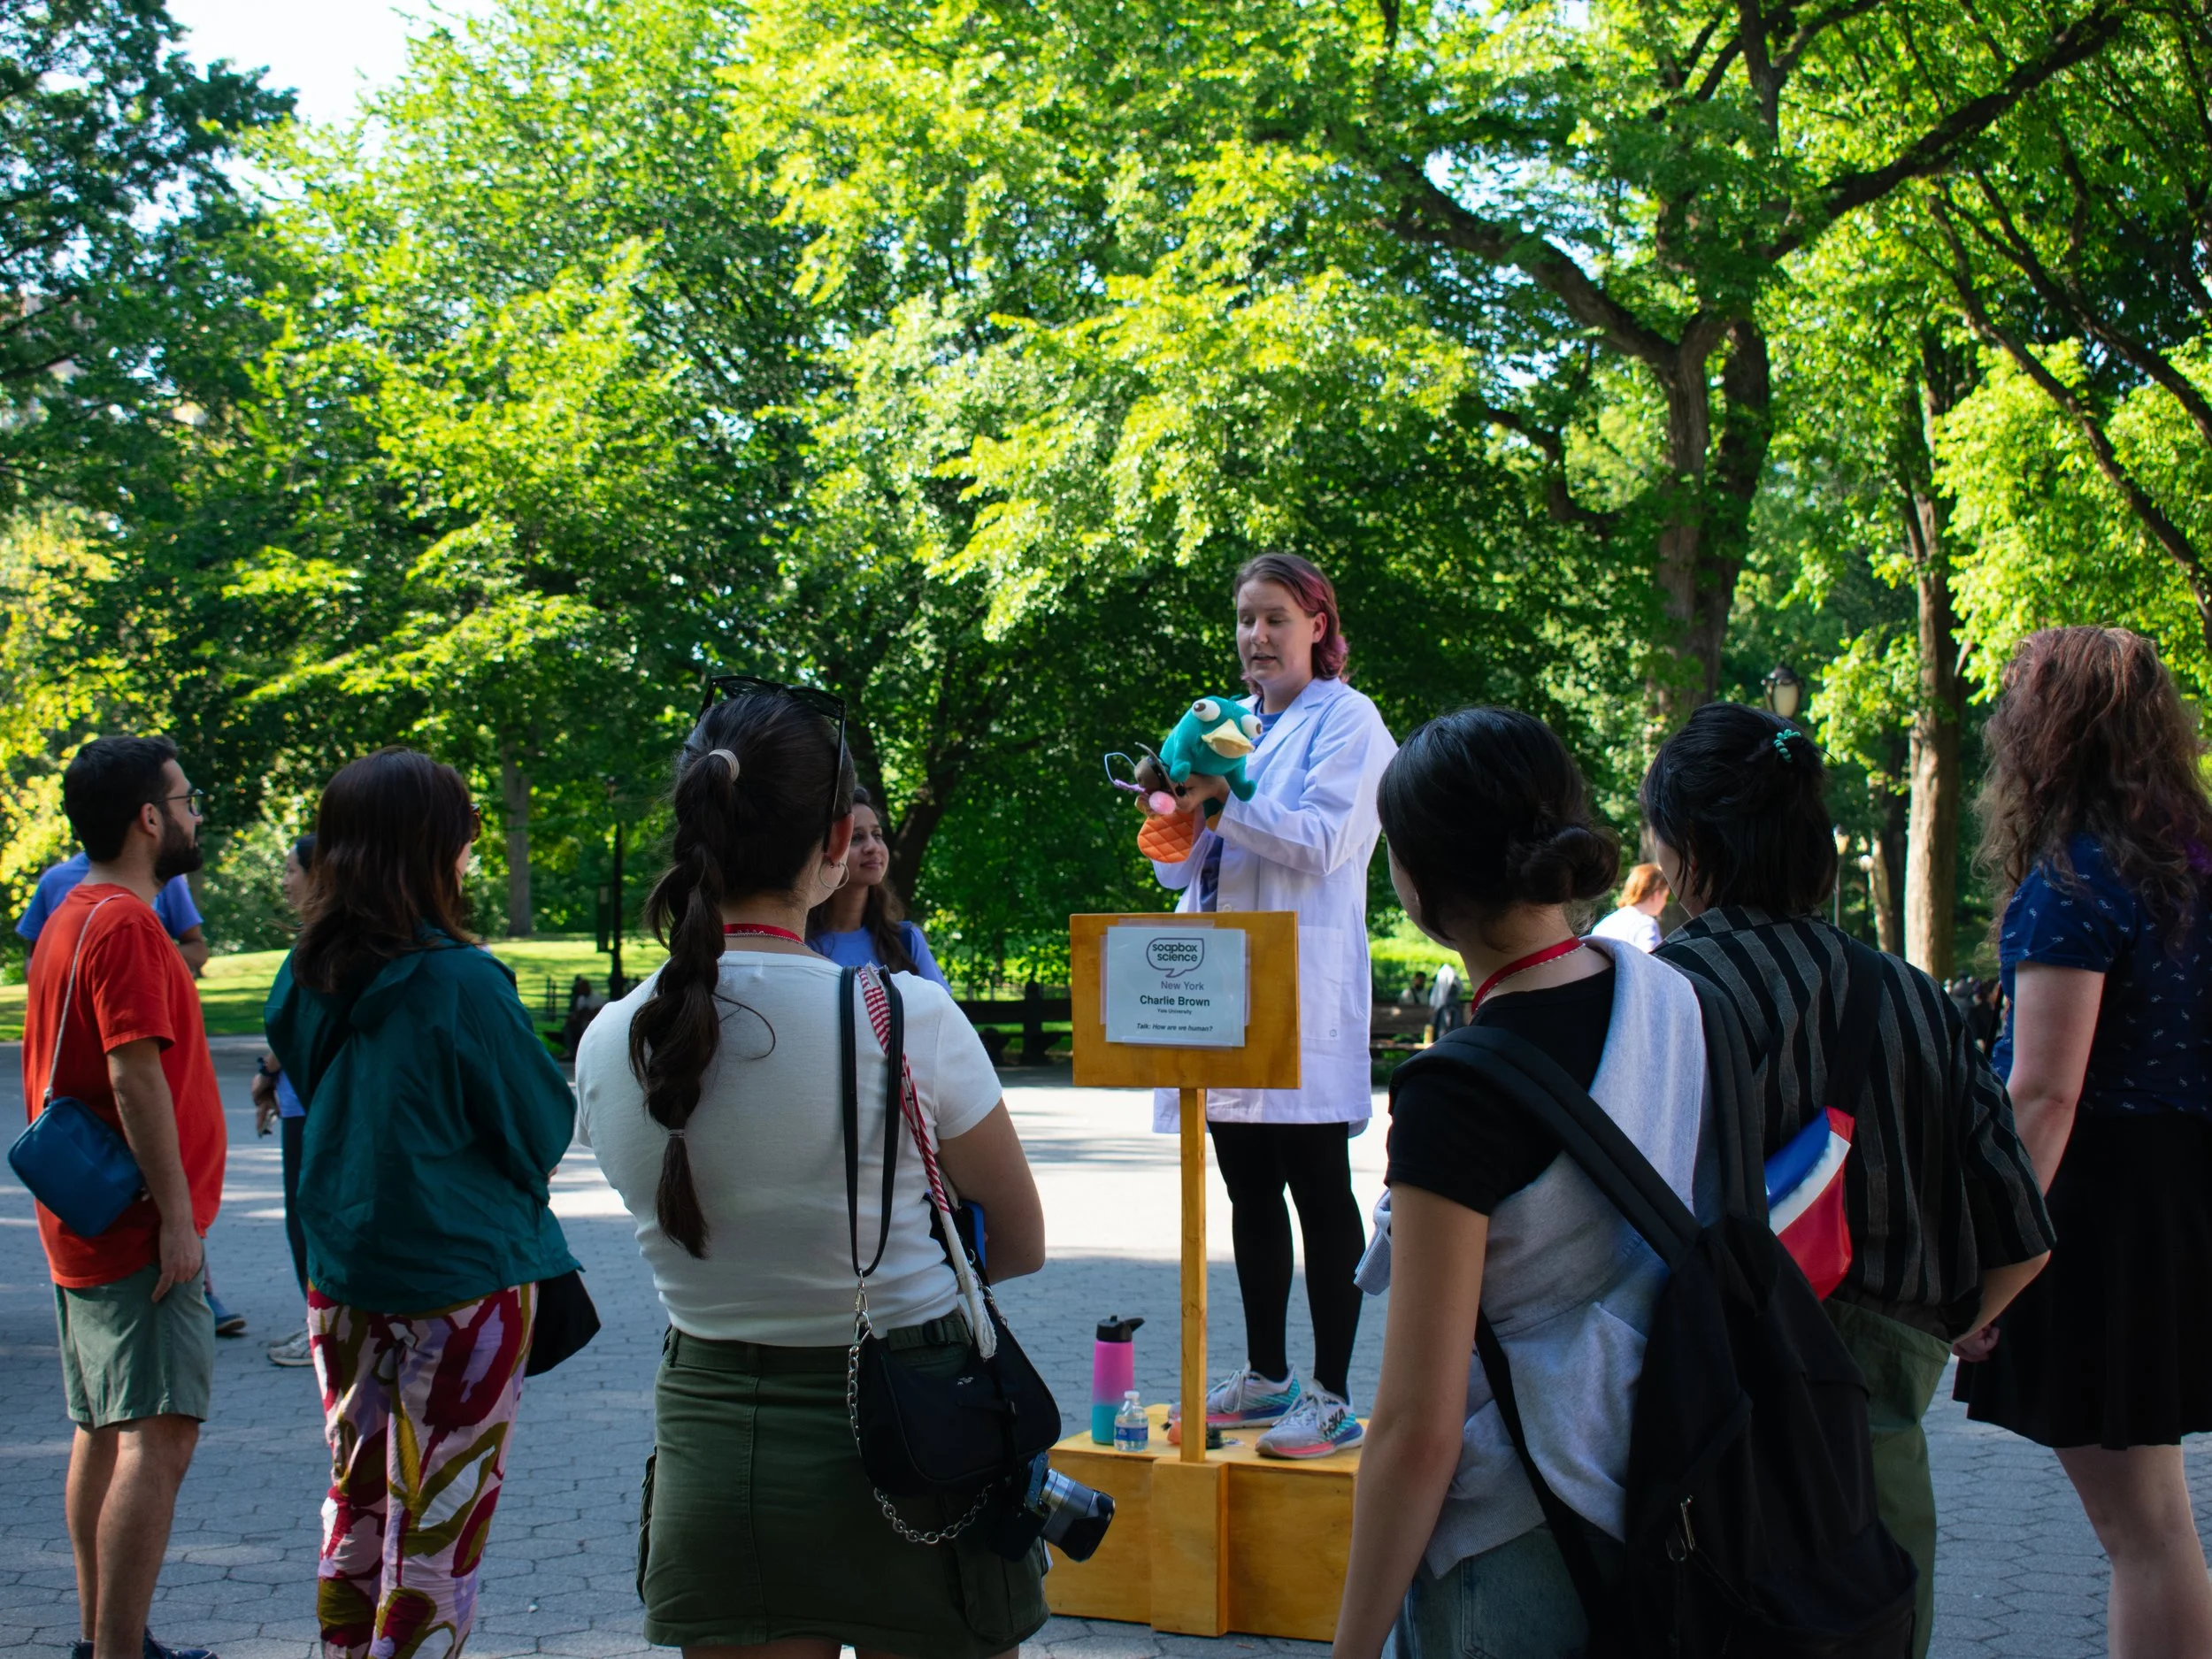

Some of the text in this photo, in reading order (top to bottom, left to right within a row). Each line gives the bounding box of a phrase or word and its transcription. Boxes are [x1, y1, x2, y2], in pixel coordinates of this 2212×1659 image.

[1152, 942, 1198, 954] soapbox
[1157, 952, 1198, 962] science
[1161, 981, 1204, 991] New York
[1140, 995, 1210, 1007] Charlie Brown
